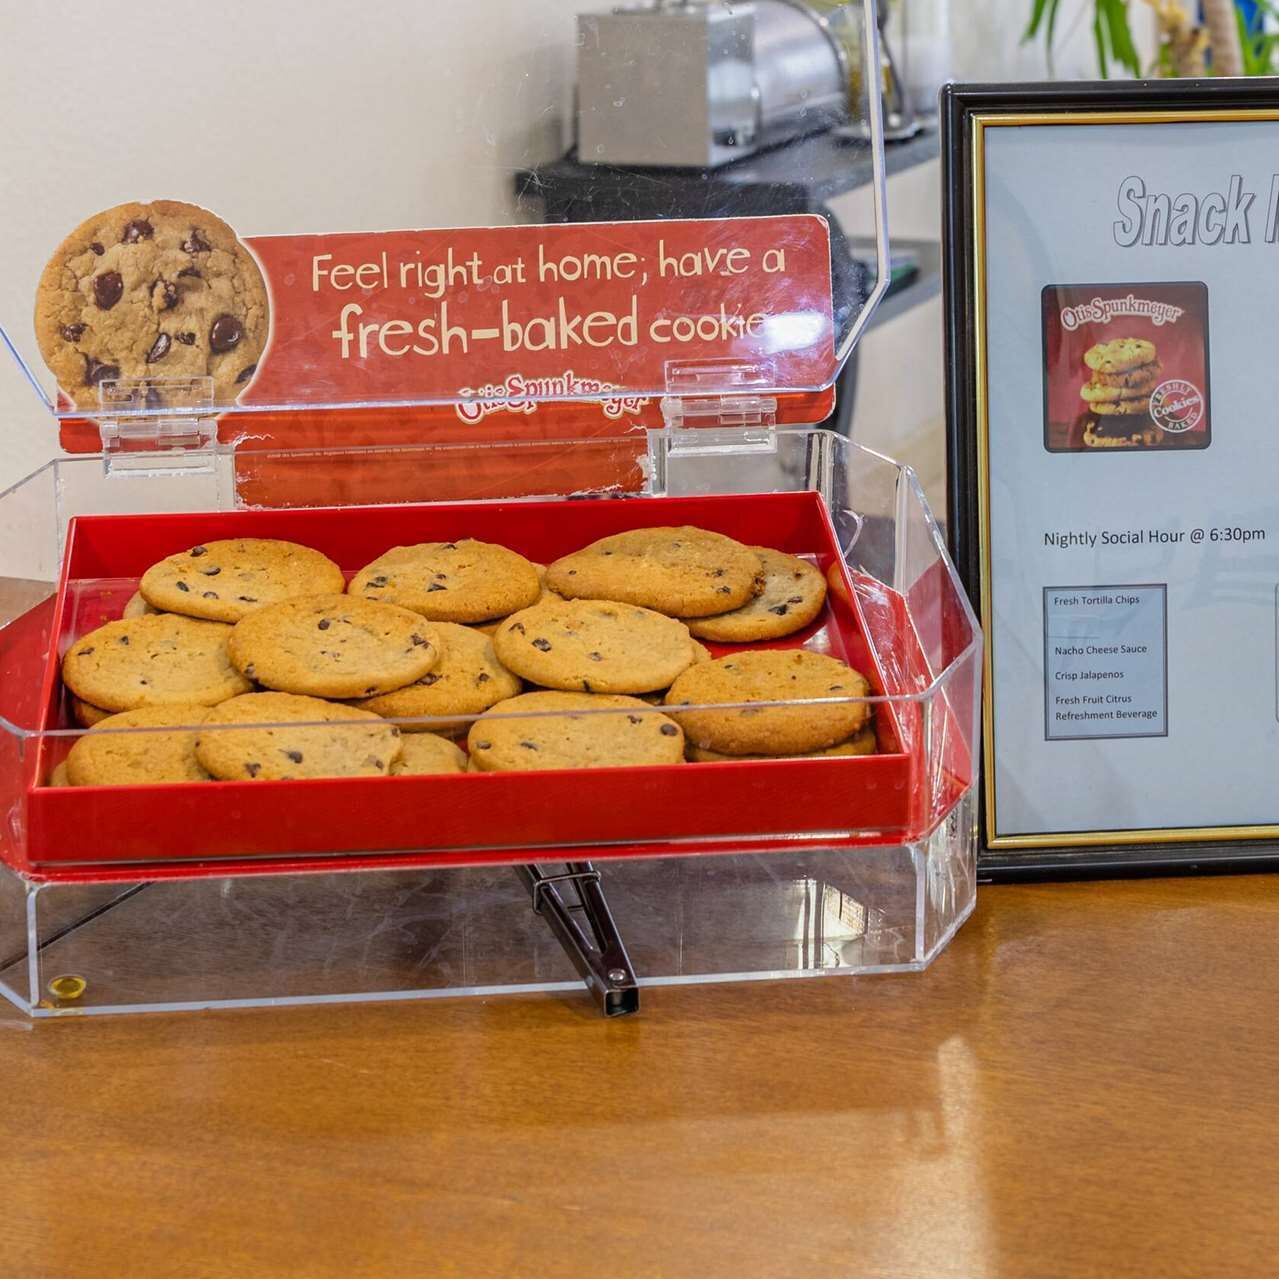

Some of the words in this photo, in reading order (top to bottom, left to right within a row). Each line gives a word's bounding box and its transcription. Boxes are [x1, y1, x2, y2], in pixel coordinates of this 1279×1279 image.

[1112, 174, 1257, 248] Snack
[311, 254, 389, 292] Feel
[399, 245, 483, 298] right
[493, 251, 527, 285] at
[537, 245, 648, 288] home;
[659, 239, 751, 280] have
[762, 246, 786, 272] a
[331, 295, 639, 359] fresh-baked
[1154, 396, 1200, 417] Cookies
[1168, 412, 1198, 430] BAKED
[1044, 529, 1097, 549] Nightly
[1101, 528, 1144, 545] Social
[1148, 528, 1186, 545] Hour
[1189, 528, 1206, 546] @
[1209, 526, 1267, 544] 6:30pm
[1054, 596, 1078, 606] Fresh
[1081, 595, 1113, 605] Tortilla
[1115, 595, 1140, 606] Chips
[1055, 646, 1083, 655] Nacho
[1086, 646, 1118, 655] Cheese
[1120, 644, 1147, 654] Sauce
[1055, 671, 1077, 682] Crisp
[1079, 669, 1125, 681] Jalapenos
[1055, 695, 1080, 705] Fresh
[1082, 694, 1104, 704] Fruit
[1106, 694, 1132, 704] Citrus
[1055, 710, 1113, 720] Refreshment
[1116, 709, 1158, 720] Beverage
